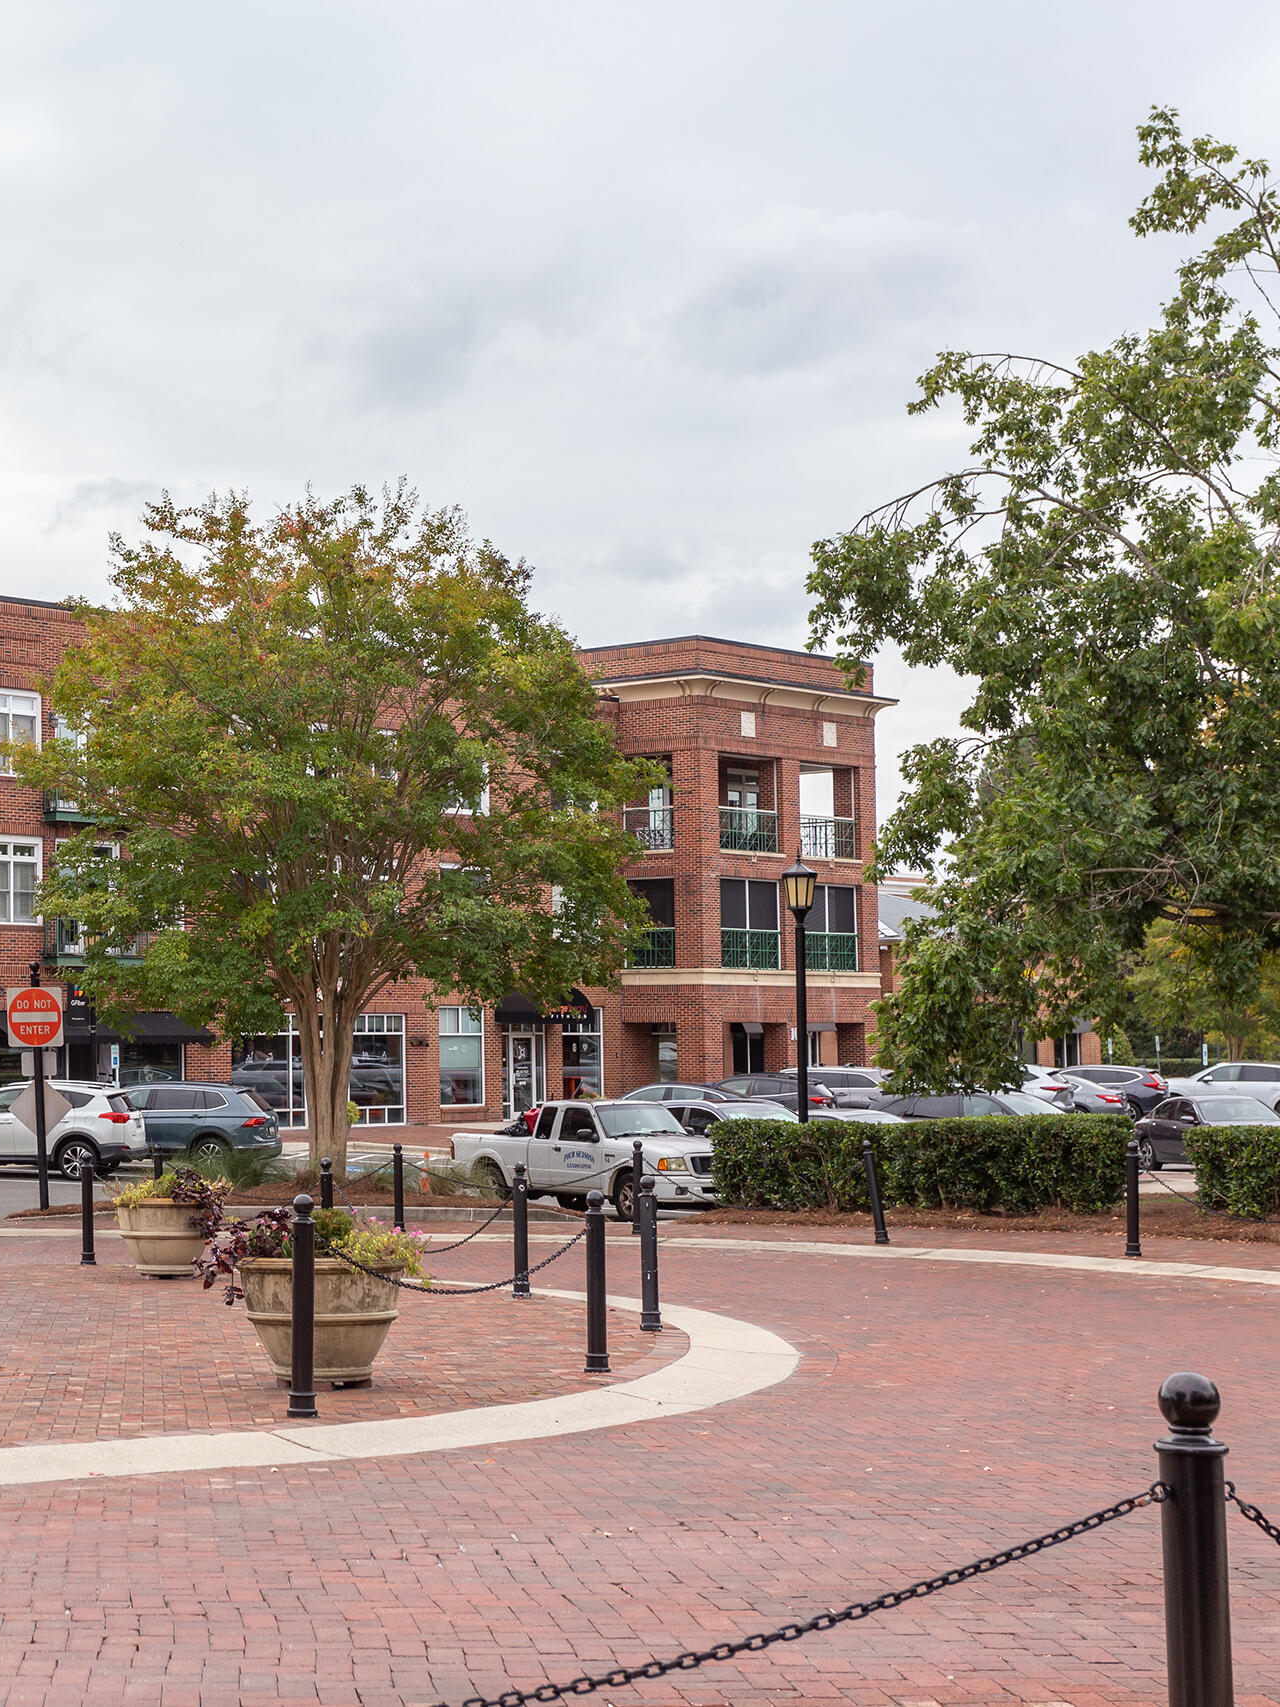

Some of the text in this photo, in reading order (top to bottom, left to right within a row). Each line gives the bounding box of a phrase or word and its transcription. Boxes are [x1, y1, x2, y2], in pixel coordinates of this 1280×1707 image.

[16, 1000, 51, 1009] DO NOT
[20, 1025, 50, 1035] ENTER
